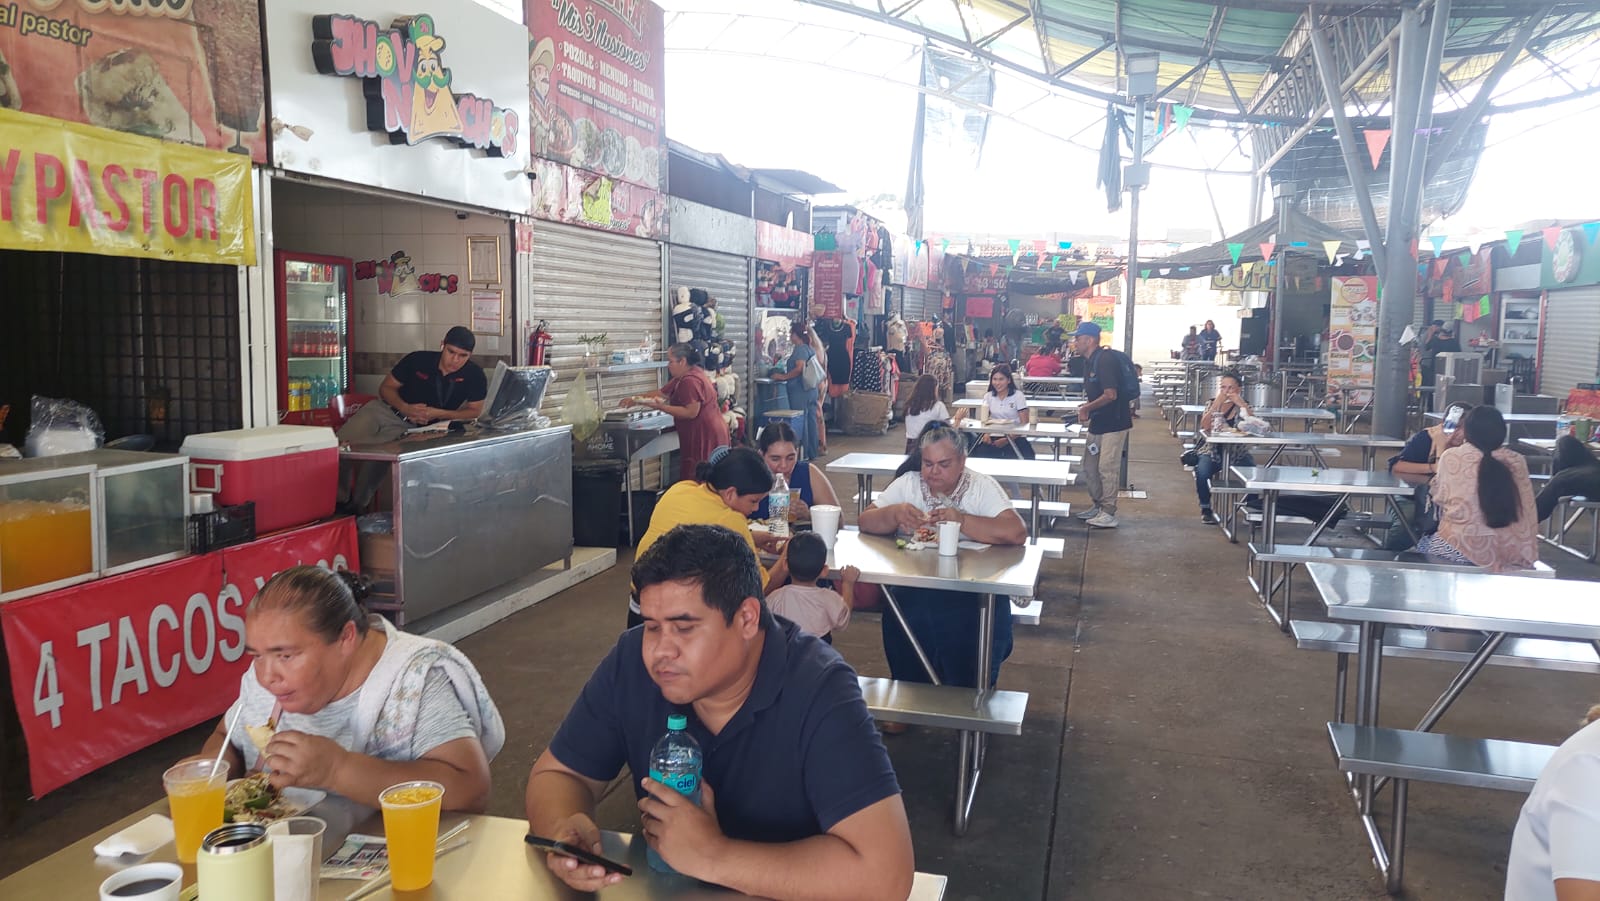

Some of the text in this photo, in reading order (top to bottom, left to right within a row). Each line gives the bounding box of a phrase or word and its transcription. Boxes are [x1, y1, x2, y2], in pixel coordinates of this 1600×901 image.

[0, 5, 18, 27] al
[20, 12, 92, 46] pastor
[583, 11, 596, 42] 3
[561, 62, 657, 119] TAQUITOS DORADOS FLAUTAS
[563, 41, 656, 101] POZOLE MENUDO BIRRIA
[35, 152, 219, 241] PASTOR
[33, 582, 246, 729] 4 TACOS
[676, 775, 695, 789] ciel
